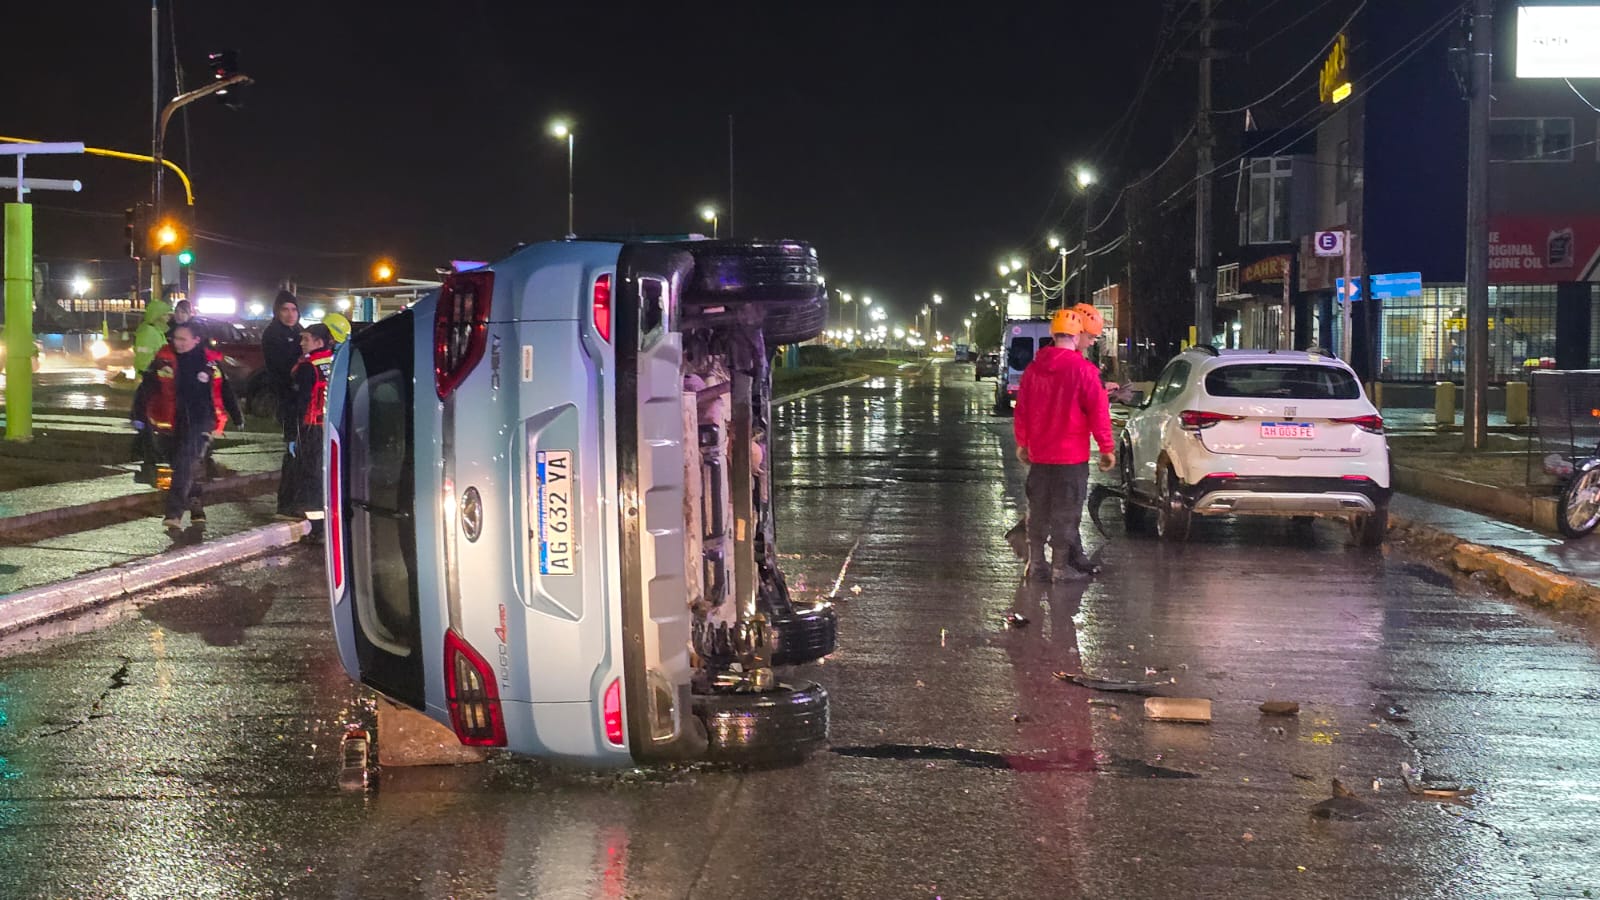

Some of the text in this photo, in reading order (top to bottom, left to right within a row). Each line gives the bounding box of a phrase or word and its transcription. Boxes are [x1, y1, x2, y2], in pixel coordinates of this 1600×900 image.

[1322, 235, 1332, 247] E
[1488, 244, 1535, 256] RIGINAL
[1523, 257, 1543, 269] OIL
[1264, 428, 1276, 437] AH
[1301, 427, 1313, 437] FE
[547, 456, 569, 570] AG 632 YA
